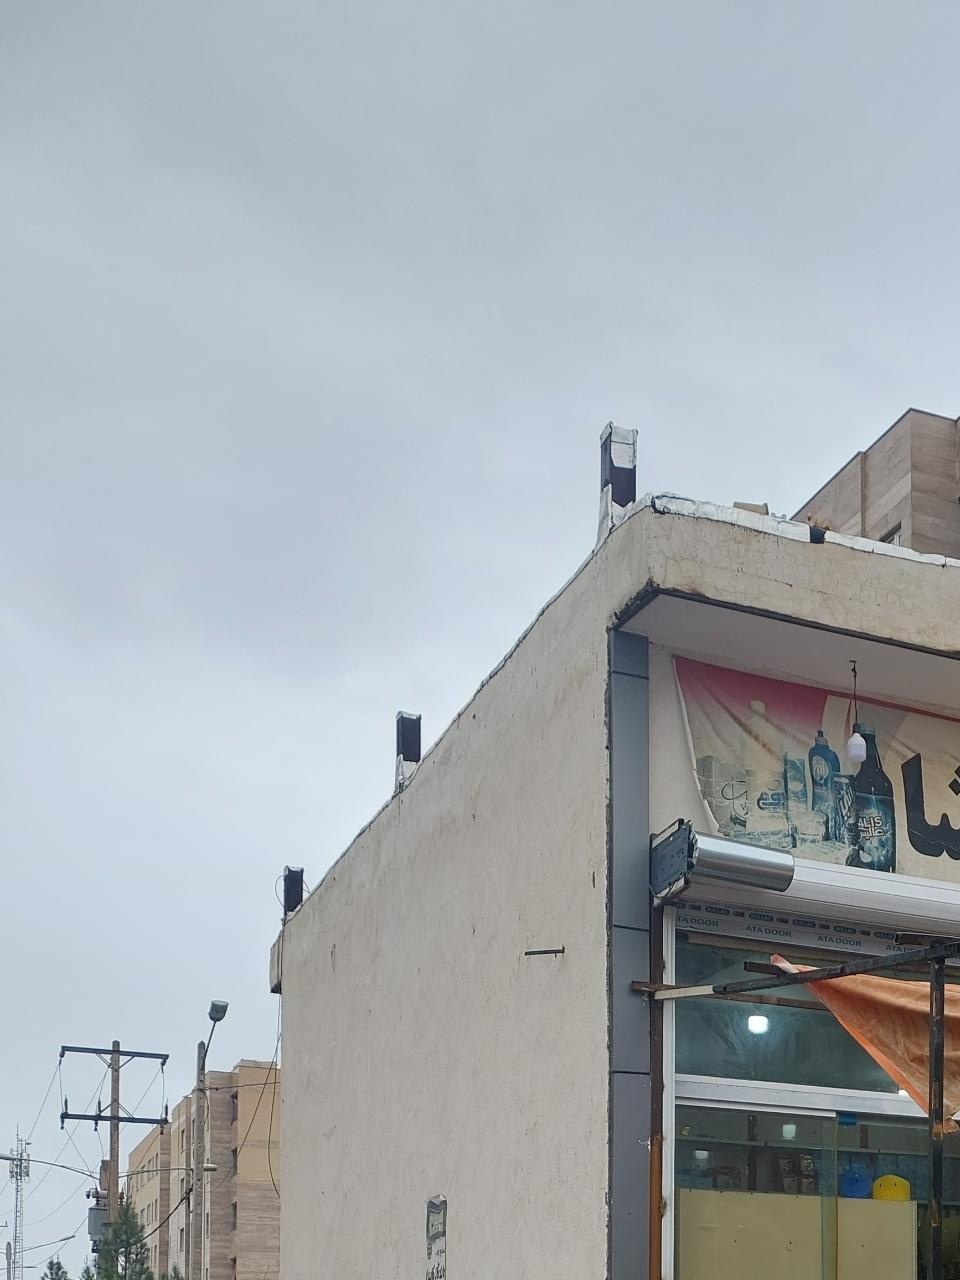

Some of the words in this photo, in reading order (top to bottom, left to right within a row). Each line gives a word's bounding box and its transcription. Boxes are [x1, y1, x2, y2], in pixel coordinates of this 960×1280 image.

[745, 925, 763, 933] ATA
[764, 928, 792, 938] DOOR
[817, 935, 834, 943] ATA
[835, 938, 862, 948] DOOR
